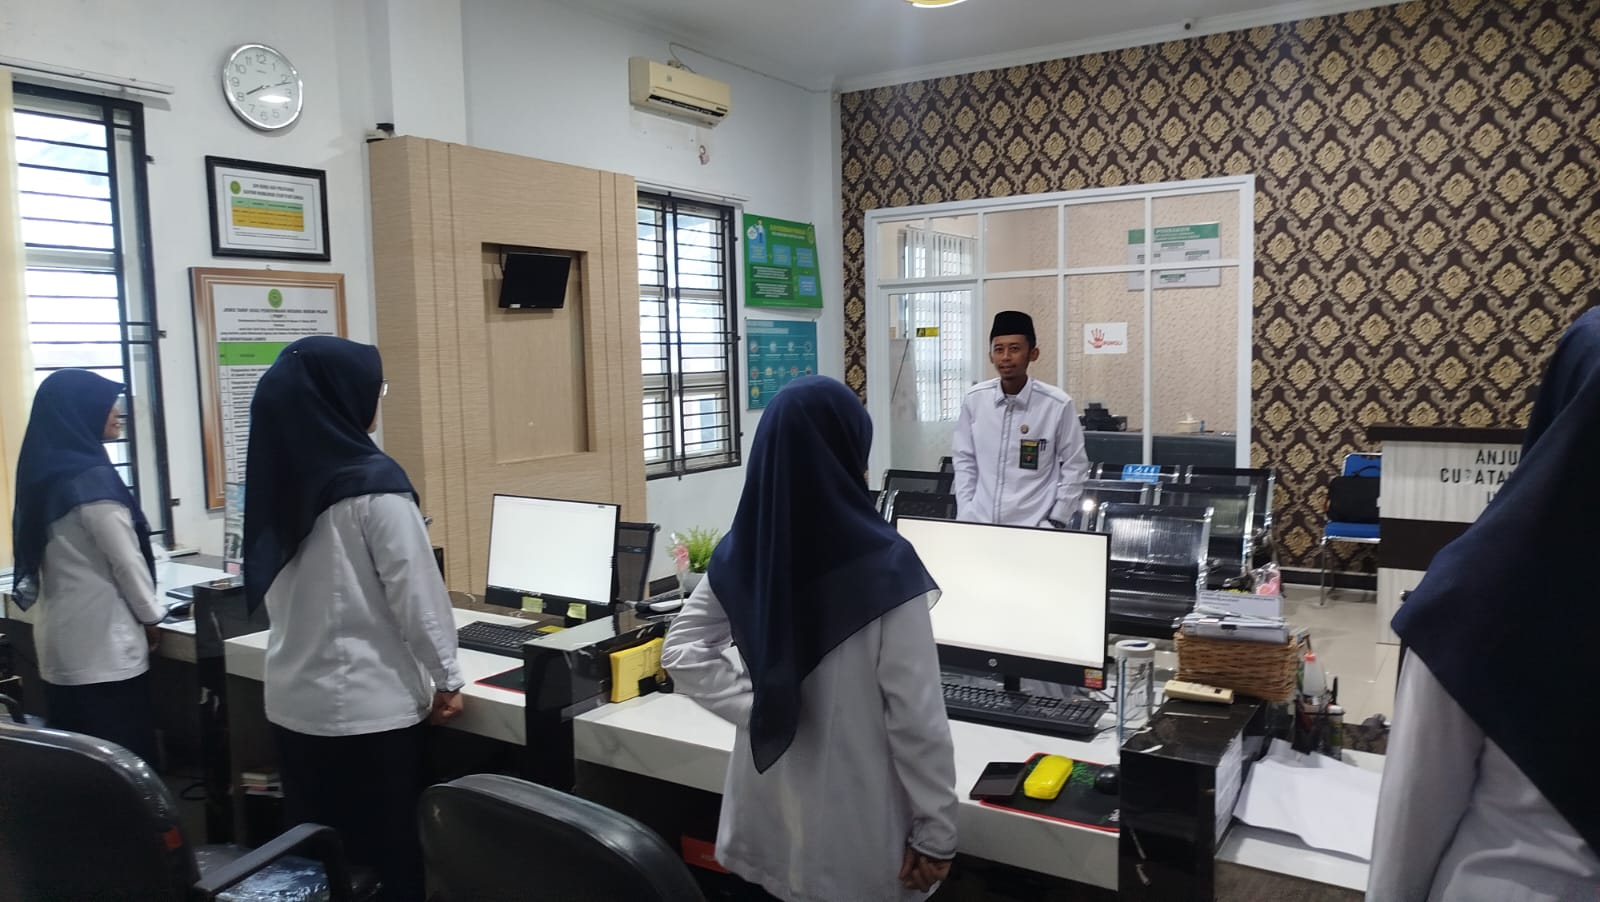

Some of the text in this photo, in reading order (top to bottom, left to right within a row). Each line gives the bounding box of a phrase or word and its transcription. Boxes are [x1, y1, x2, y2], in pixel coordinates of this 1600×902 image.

[245, 56, 253, 66] 11
[256, 53, 267, 65] 12
[235, 63, 247, 74] 10
[231, 76, 240, 87] 9
[280, 74, 288, 84] 2
[236, 91, 246, 102] 8
[248, 103, 256, 113] 7
[272, 108, 280, 119] 5
